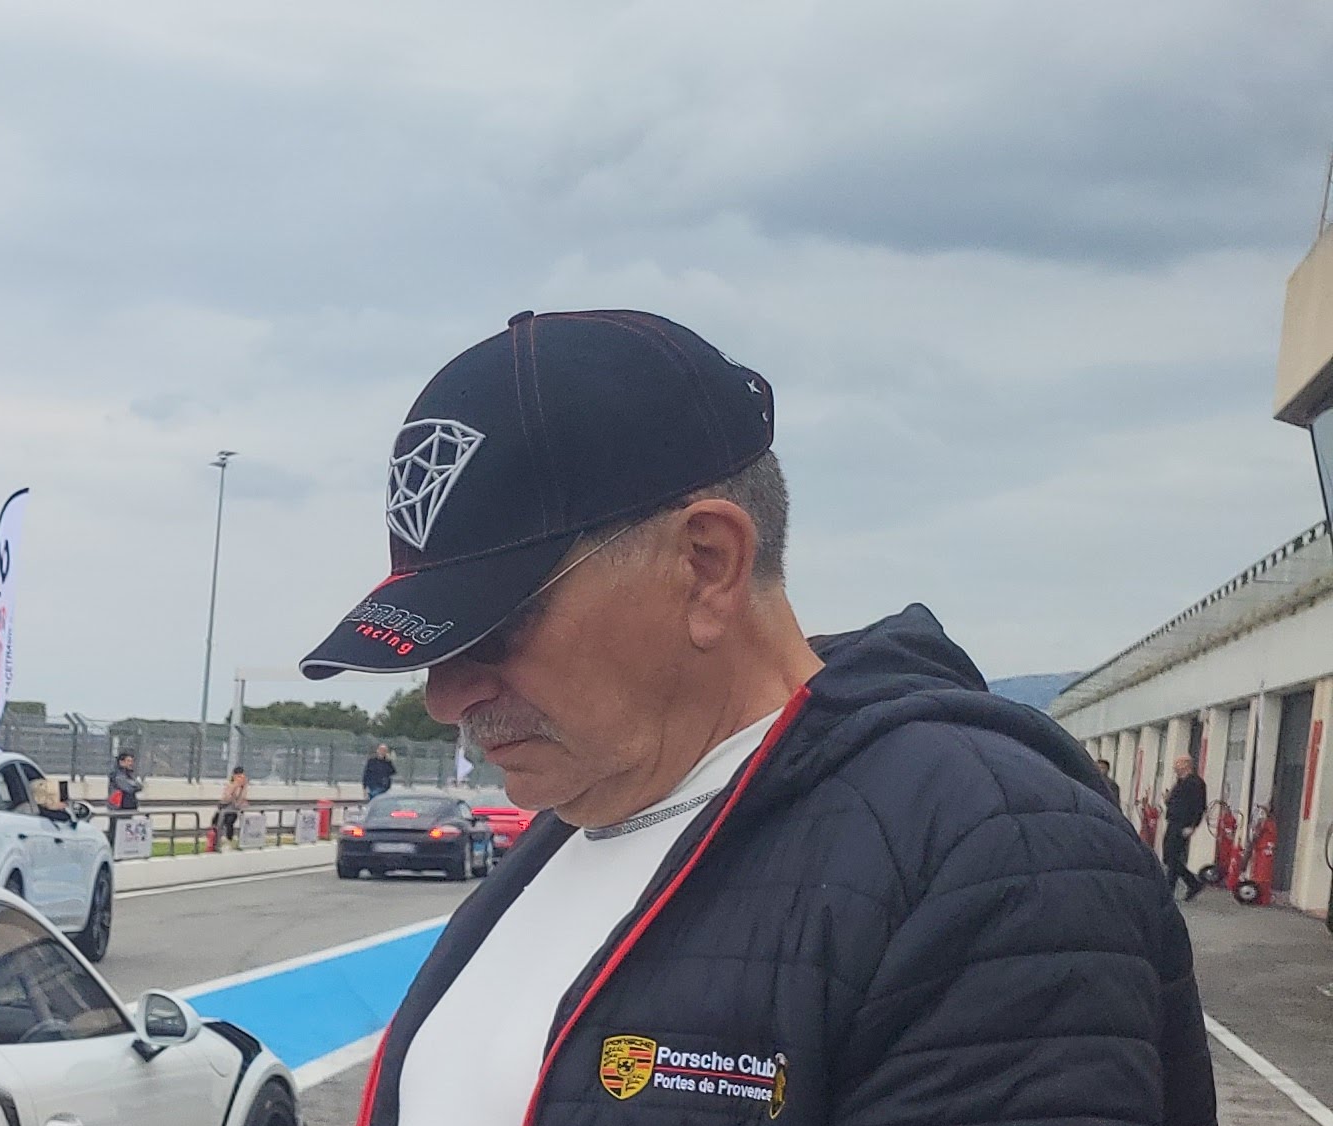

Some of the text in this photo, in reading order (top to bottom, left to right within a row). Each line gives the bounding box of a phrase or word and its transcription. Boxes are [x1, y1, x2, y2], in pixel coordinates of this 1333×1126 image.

[355, 624, 414, 655] racing
[656, 1046, 777, 1078] Porsche Club
[653, 1072, 772, 1101] Portes de Provence
